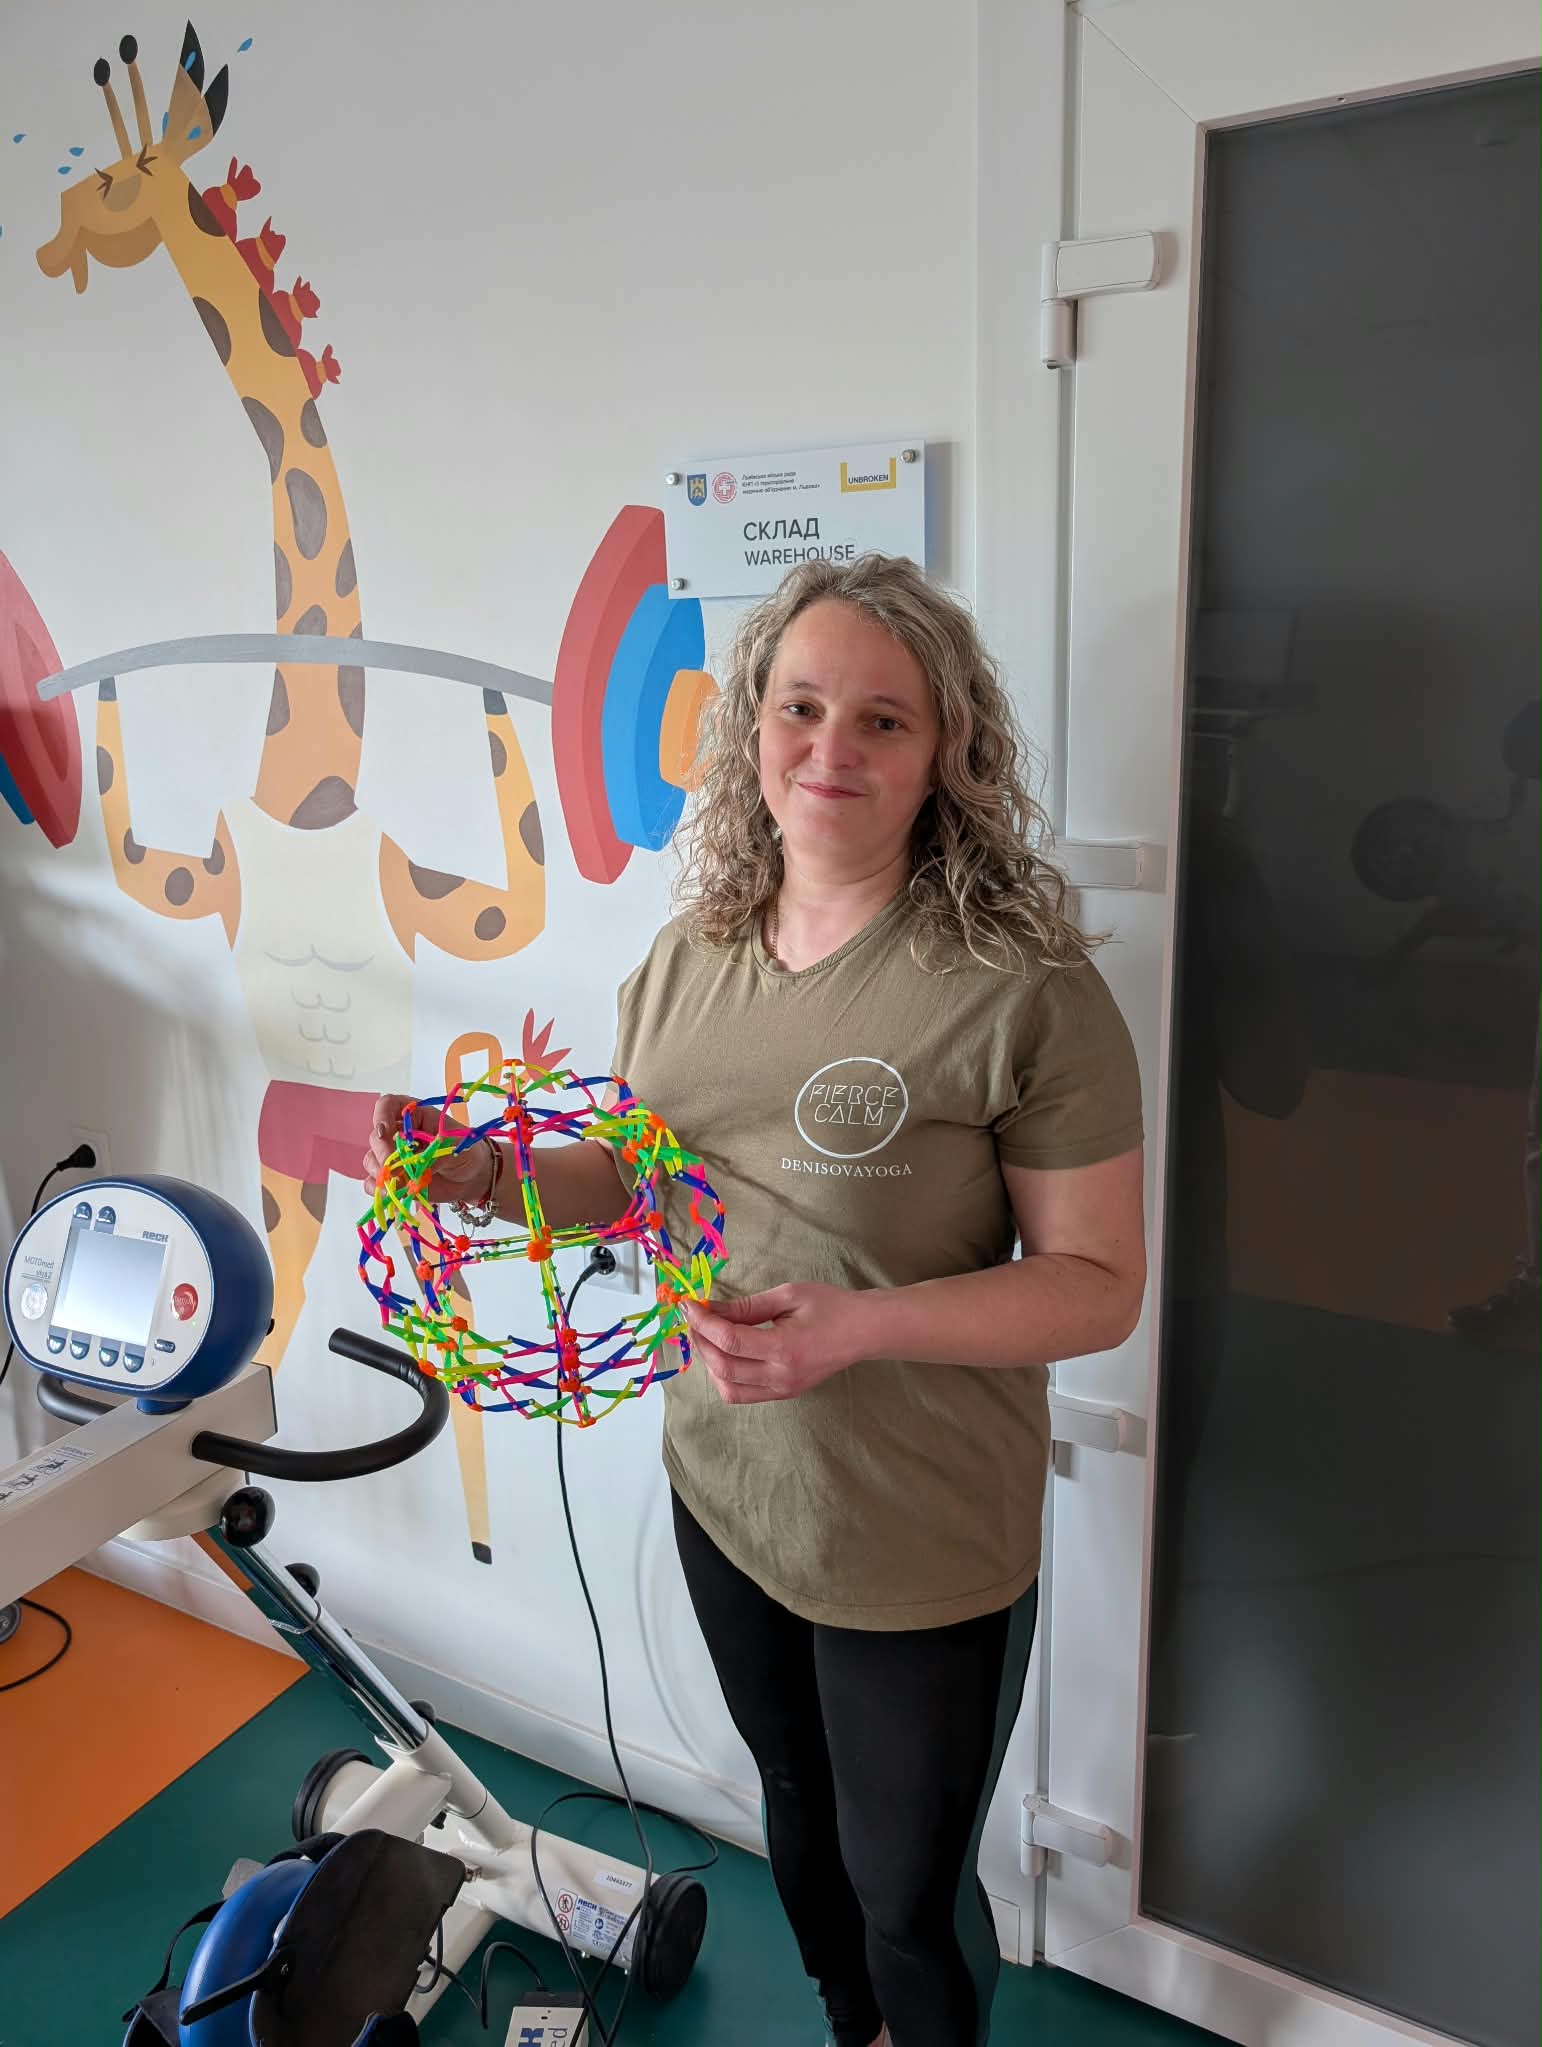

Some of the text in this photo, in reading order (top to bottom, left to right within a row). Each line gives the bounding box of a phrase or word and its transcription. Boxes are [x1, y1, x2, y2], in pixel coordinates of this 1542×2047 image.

[848, 474, 889, 485] UNBROKEN
[743, 517, 820, 541] СКЛАД
[745, 544, 855, 566] WAREHOUSE
[809, 1084, 901, 1107] FIERCE
[814, 1103, 884, 1126] CALM
[781, 1157, 912, 1177] DENISOVAYOGA
